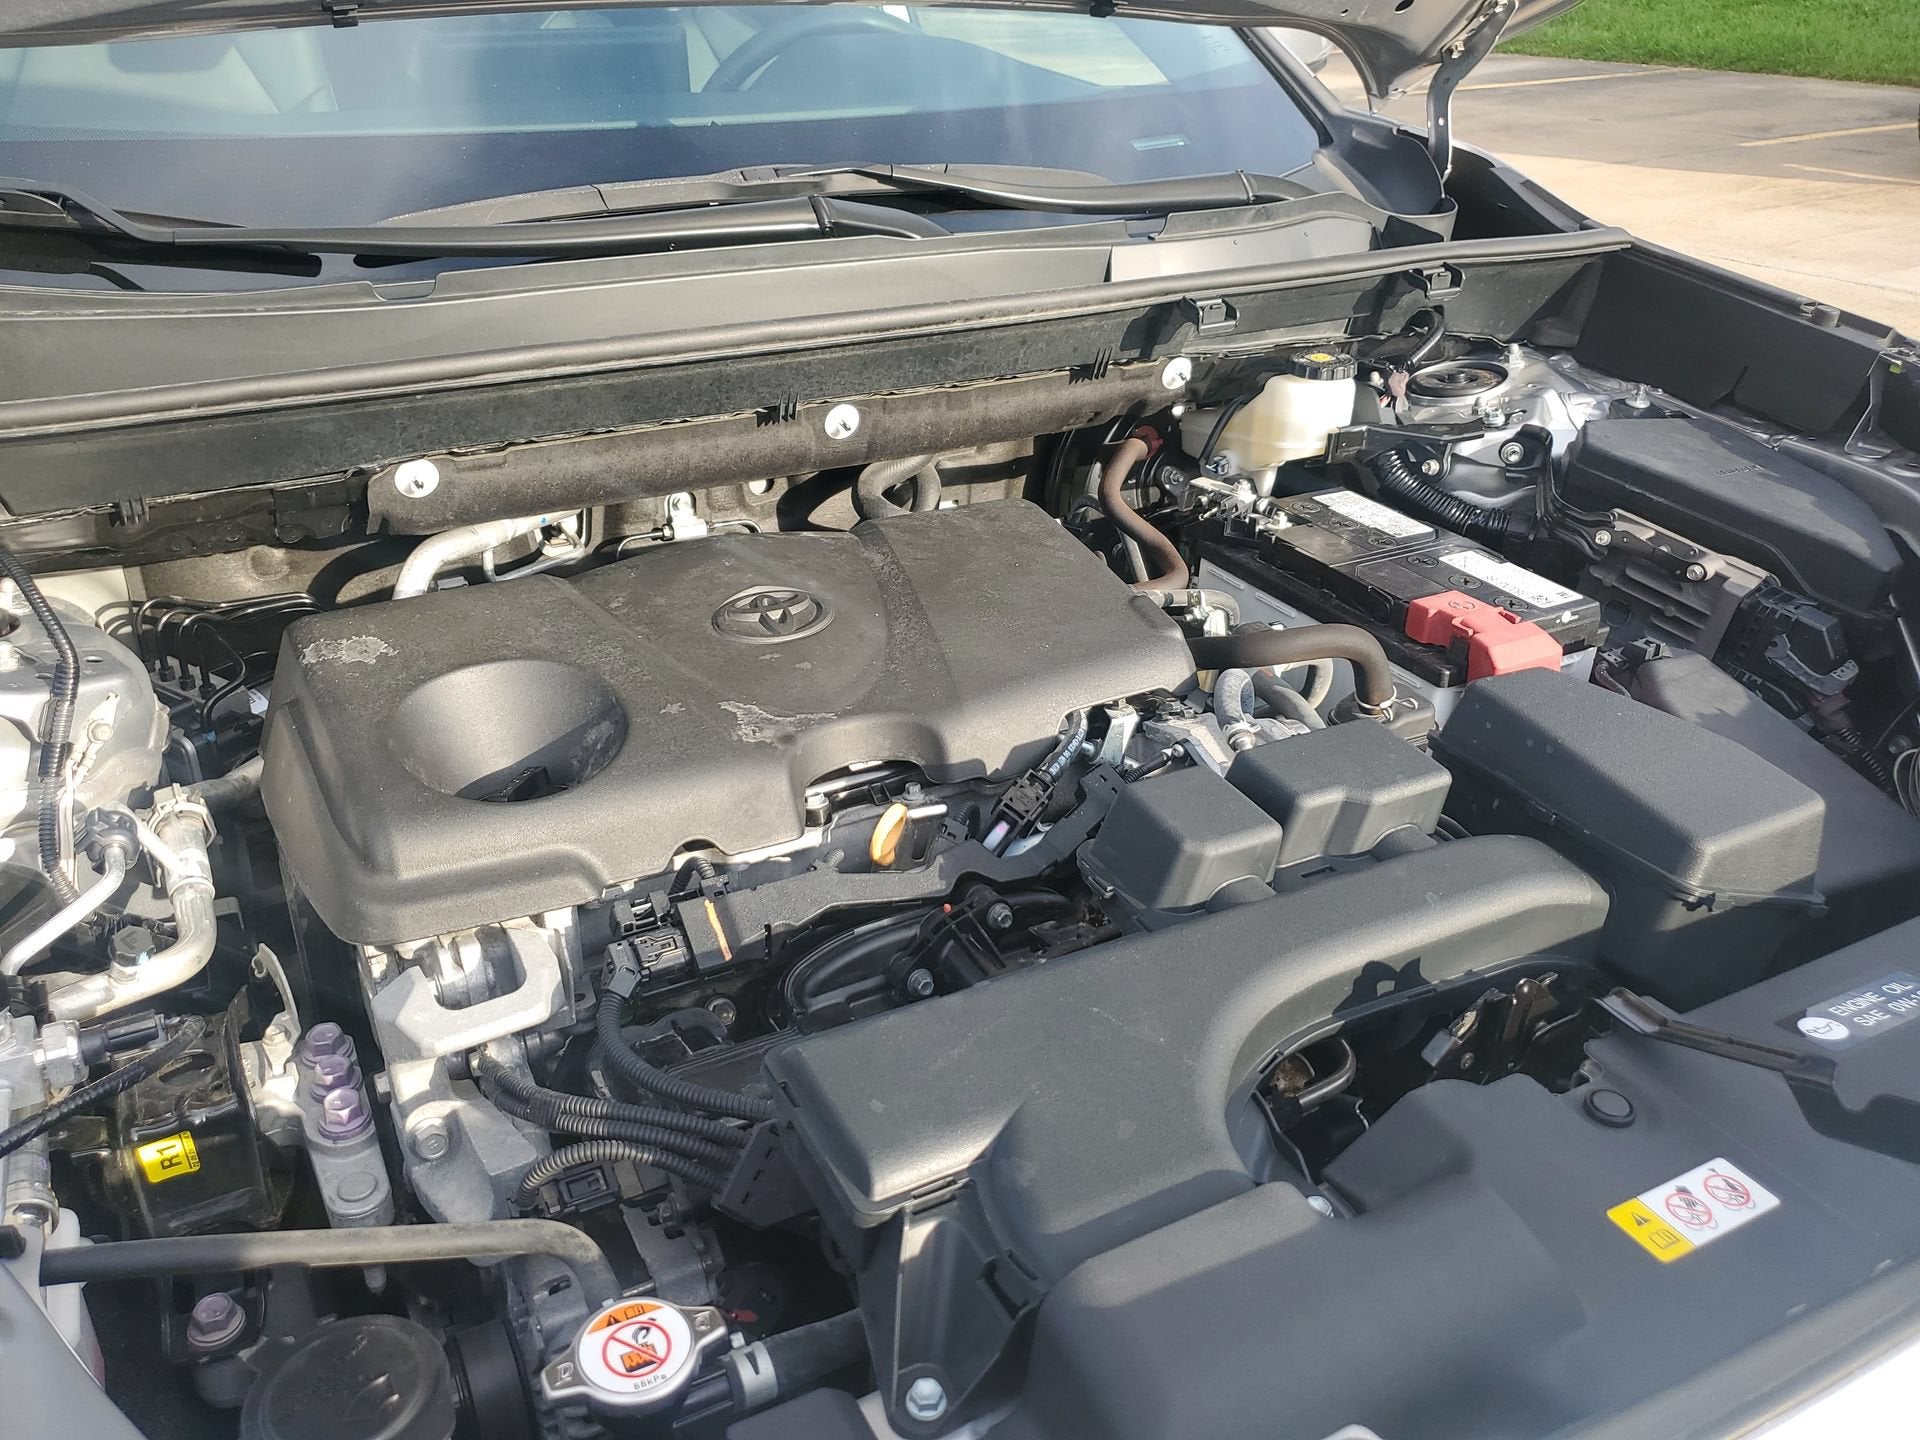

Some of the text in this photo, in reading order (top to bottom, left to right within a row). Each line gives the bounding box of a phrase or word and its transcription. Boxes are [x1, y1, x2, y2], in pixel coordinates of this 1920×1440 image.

[1828, 982, 1913, 1016] ENGINE OIL
[1853, 1009, 1892, 1026] SAE
[156, 1144, 182, 1170] R1
